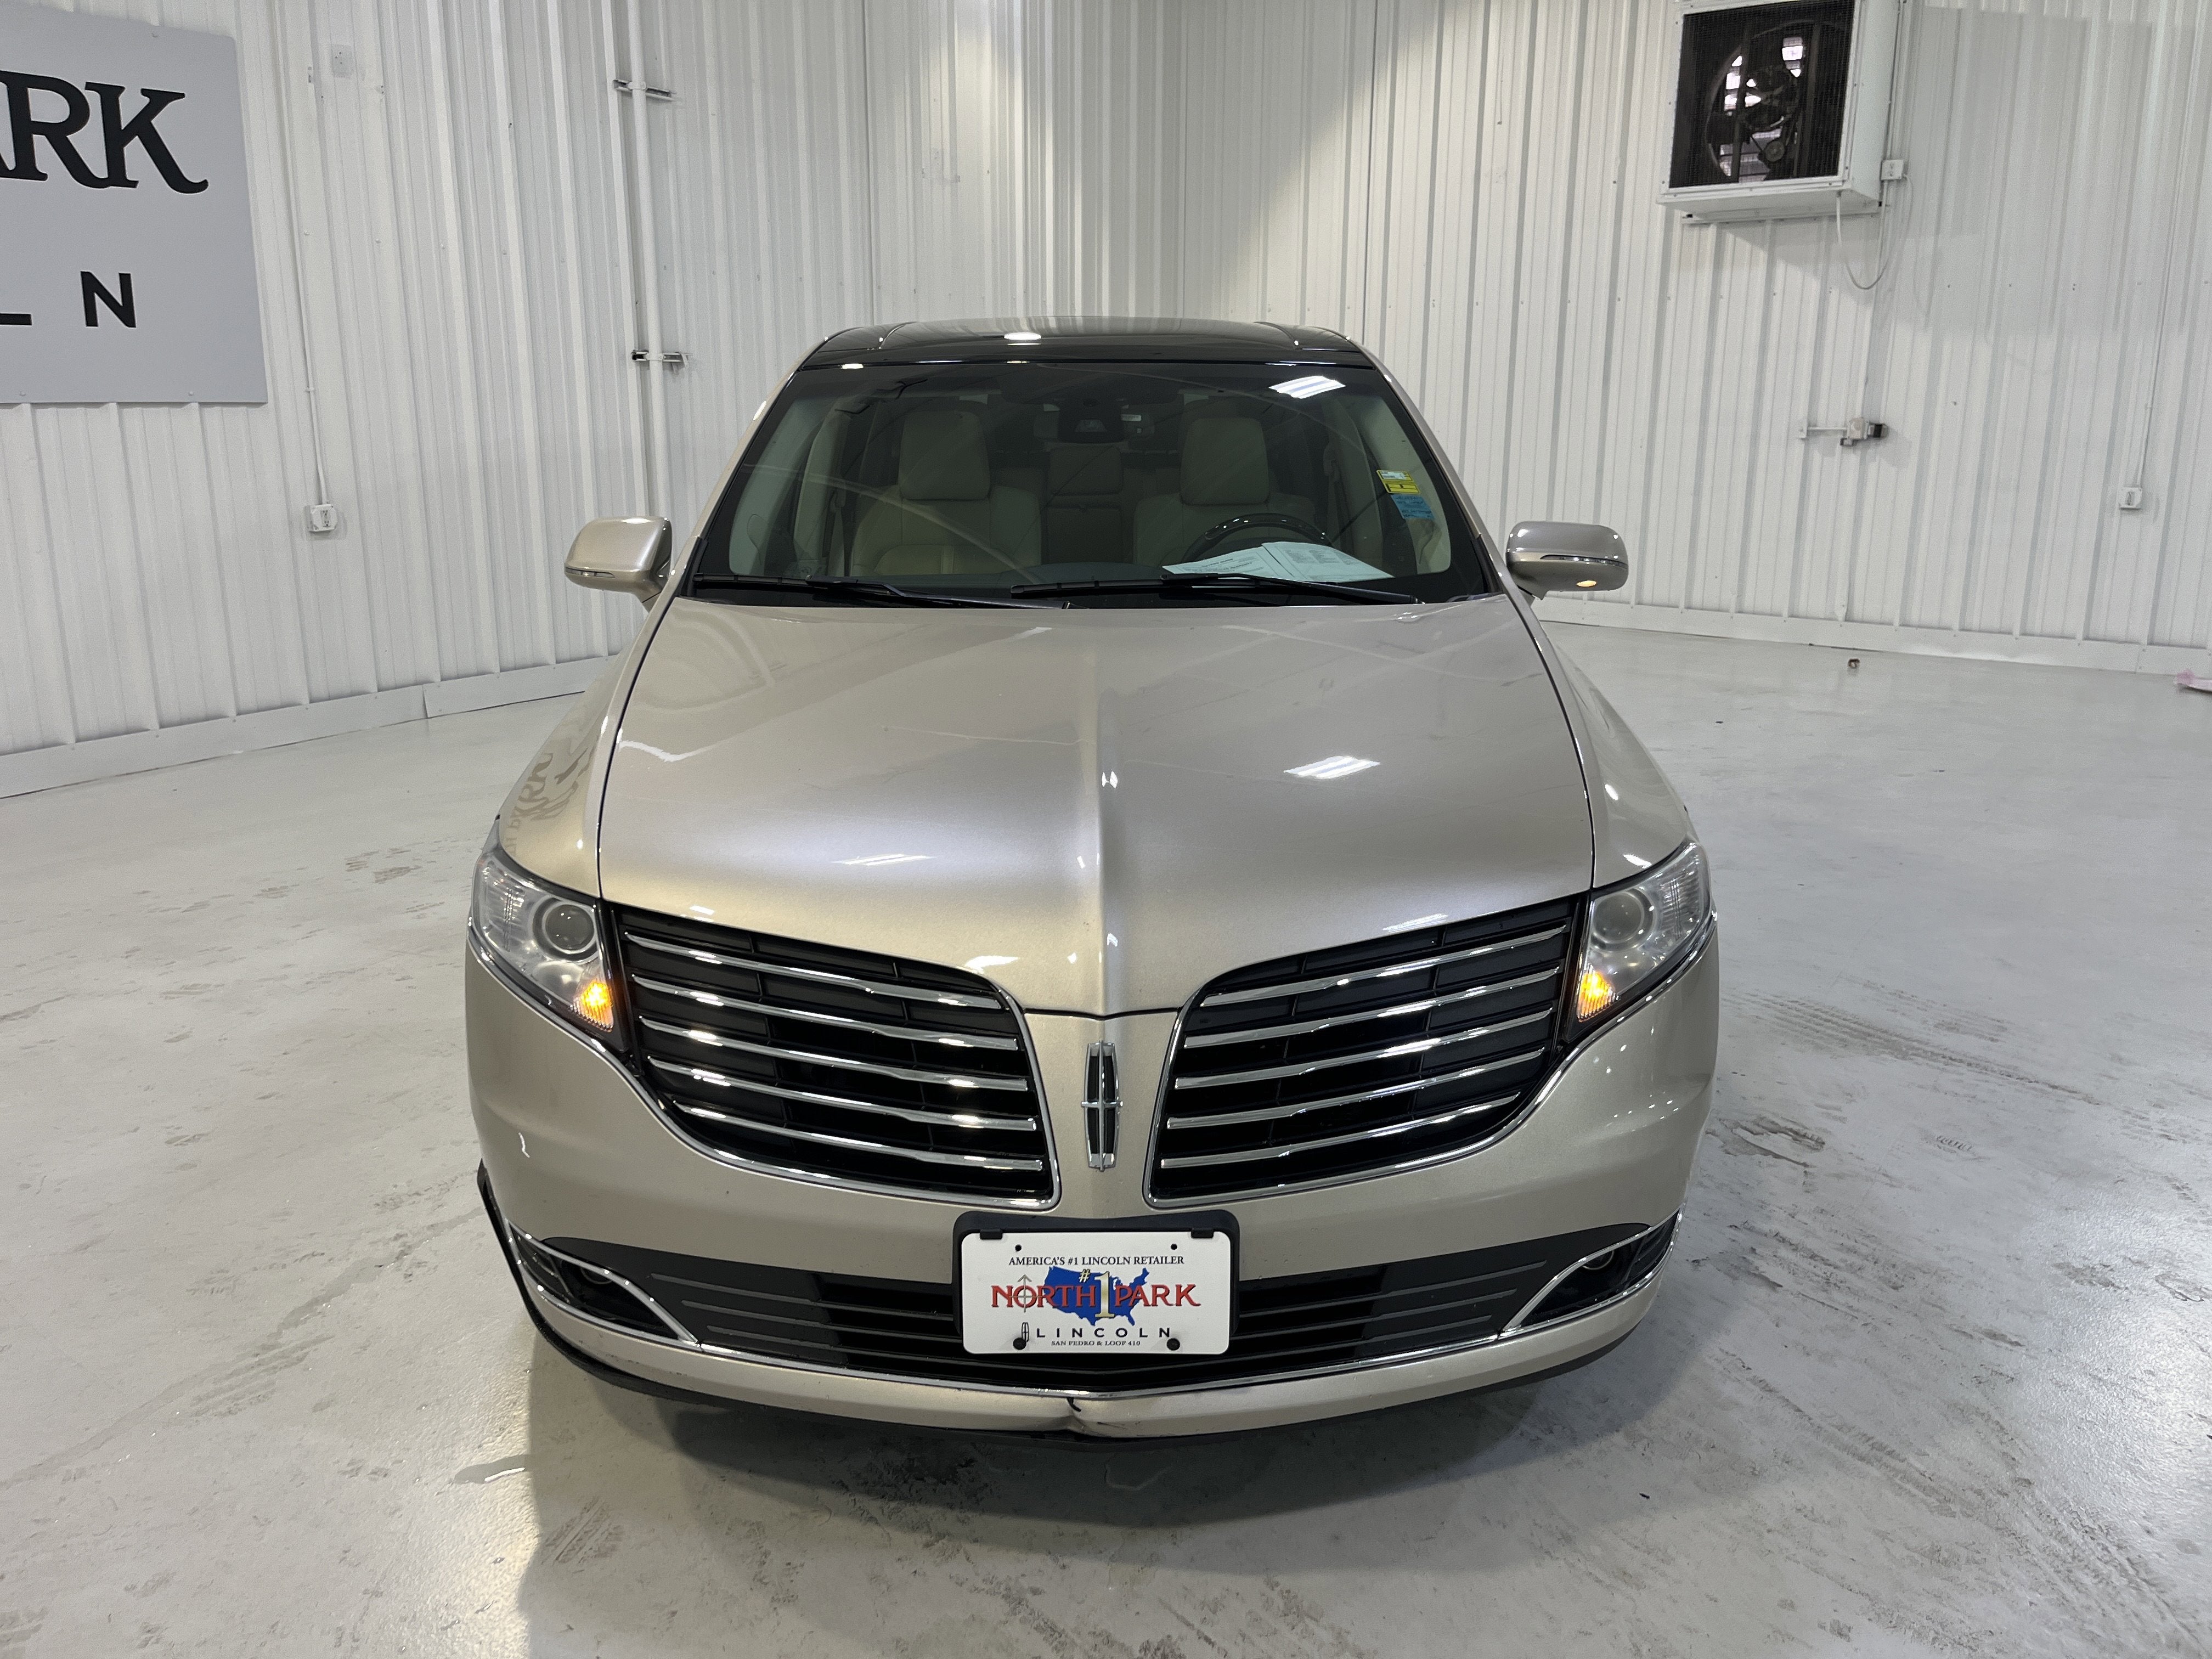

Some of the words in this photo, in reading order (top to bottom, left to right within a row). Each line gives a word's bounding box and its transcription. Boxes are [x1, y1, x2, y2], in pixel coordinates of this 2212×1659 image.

[0, 71, 208, 194] RK
[1009, 1256, 1065, 1266] AMERICA'S
[1068, 1257, 1078, 1265] #1
[1082, 1256, 1131, 1265] LINCOLN
[1133, 1256, 1184, 1265] RETAILER
[991, 1285, 1096, 1308] NORTH
[1114, 1284, 1201, 1307] PARK
[1036, 1328, 1170, 1338] LINCOLN
